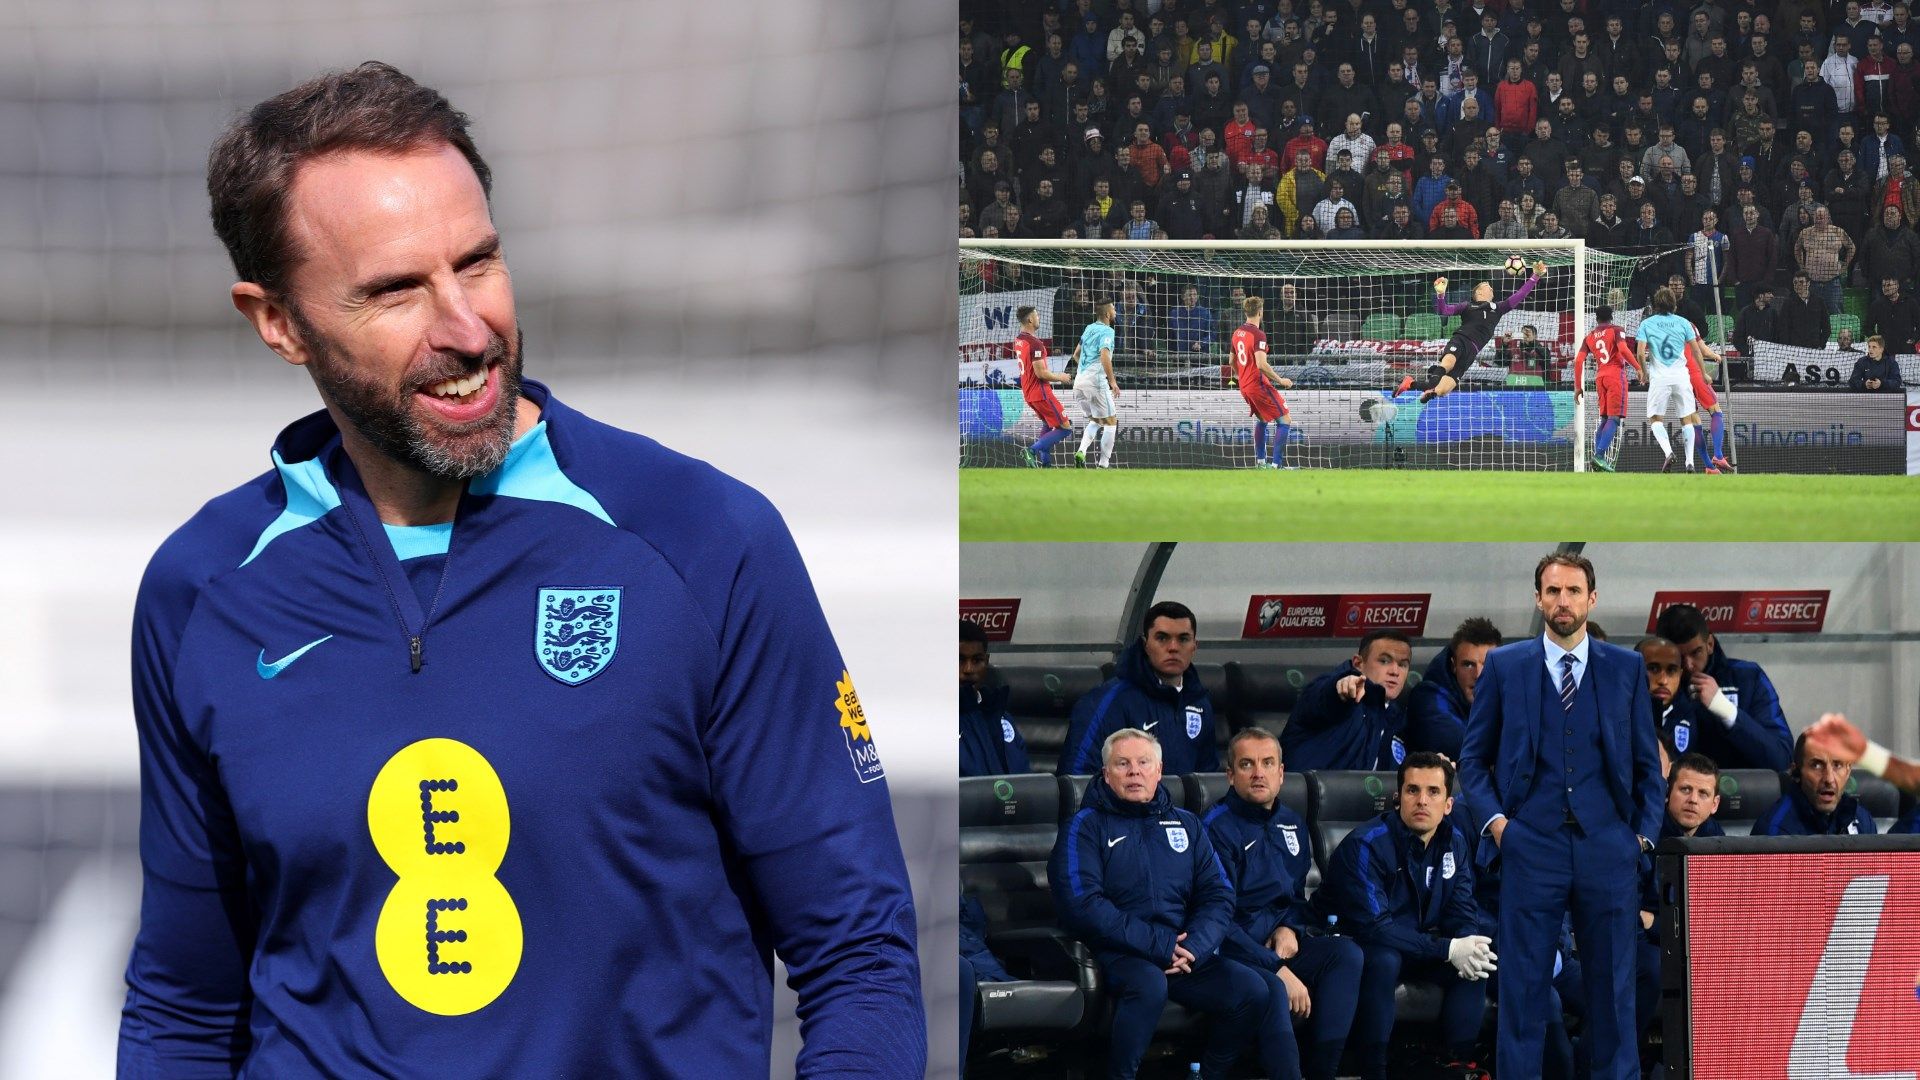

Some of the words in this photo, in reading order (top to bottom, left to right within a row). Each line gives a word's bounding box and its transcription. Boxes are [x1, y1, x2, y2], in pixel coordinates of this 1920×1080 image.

[982, 305, 1012, 330] W
[1237, 340, 1247, 366] 8
[1595, 339, 1610, 364] 3
[1660, 334, 1674, 360] 6
[1286, 607, 1324, 616] EUROPEAN
[1364, 607, 1421, 624] RESPECT
[1764, 603, 1821, 619] RESPECT
[959, 612, 1011, 628] ESPECT
[1279, 616, 1326, 628] QUALIFIERS
[843, 692, 858, 706] ea
[856, 744, 877, 766] M&
